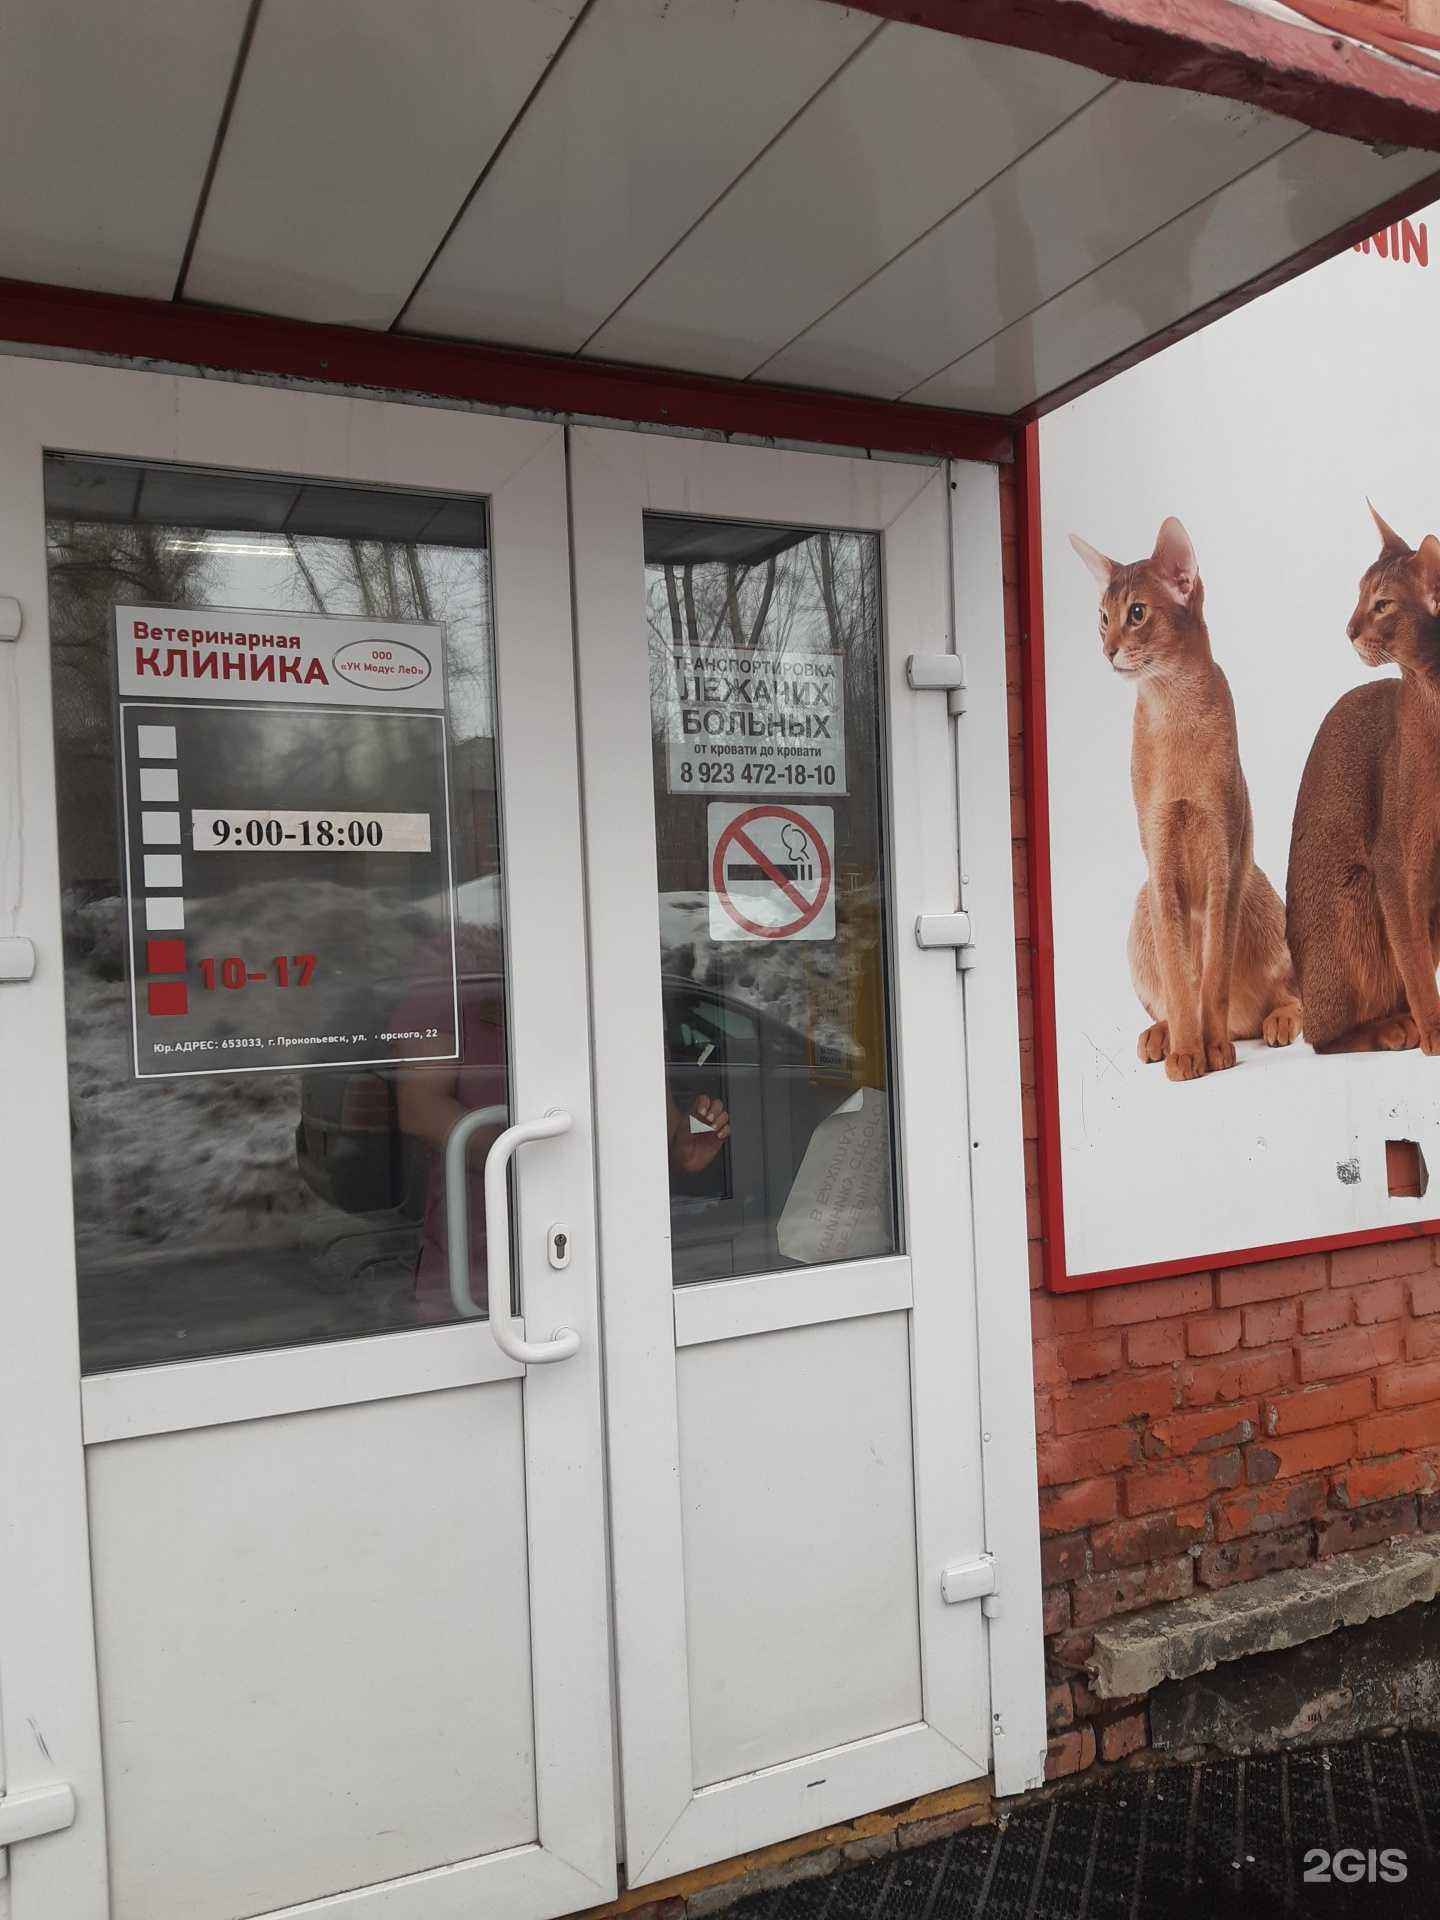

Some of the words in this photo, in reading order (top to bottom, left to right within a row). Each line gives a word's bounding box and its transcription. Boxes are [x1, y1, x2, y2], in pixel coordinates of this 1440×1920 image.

[132, 620, 302, 650] Ветеринарная
[135, 646, 330, 686] КЛИНИКА
[371, 650, 394, 661] ООО
[363, 663, 396, 676] Модус
[682, 709, 833, 740] БОЛЬНЫХ
[694, 745, 707, 754] от
[710, 745, 757, 758] кровати
[760, 746, 775, 758] до
[776, 747, 823, 759] кровати
[680, 763, 693, 784] 8
[698, 763, 735, 784] 923
[741, 764, 836, 785] 472-18-10
[212, 819, 384, 847] 9:00-18:00
[221, 1036, 265, 1050] 653033,
[352, 1033, 367, 1043] ул.
[425, 1028, 438, 1038] 22
